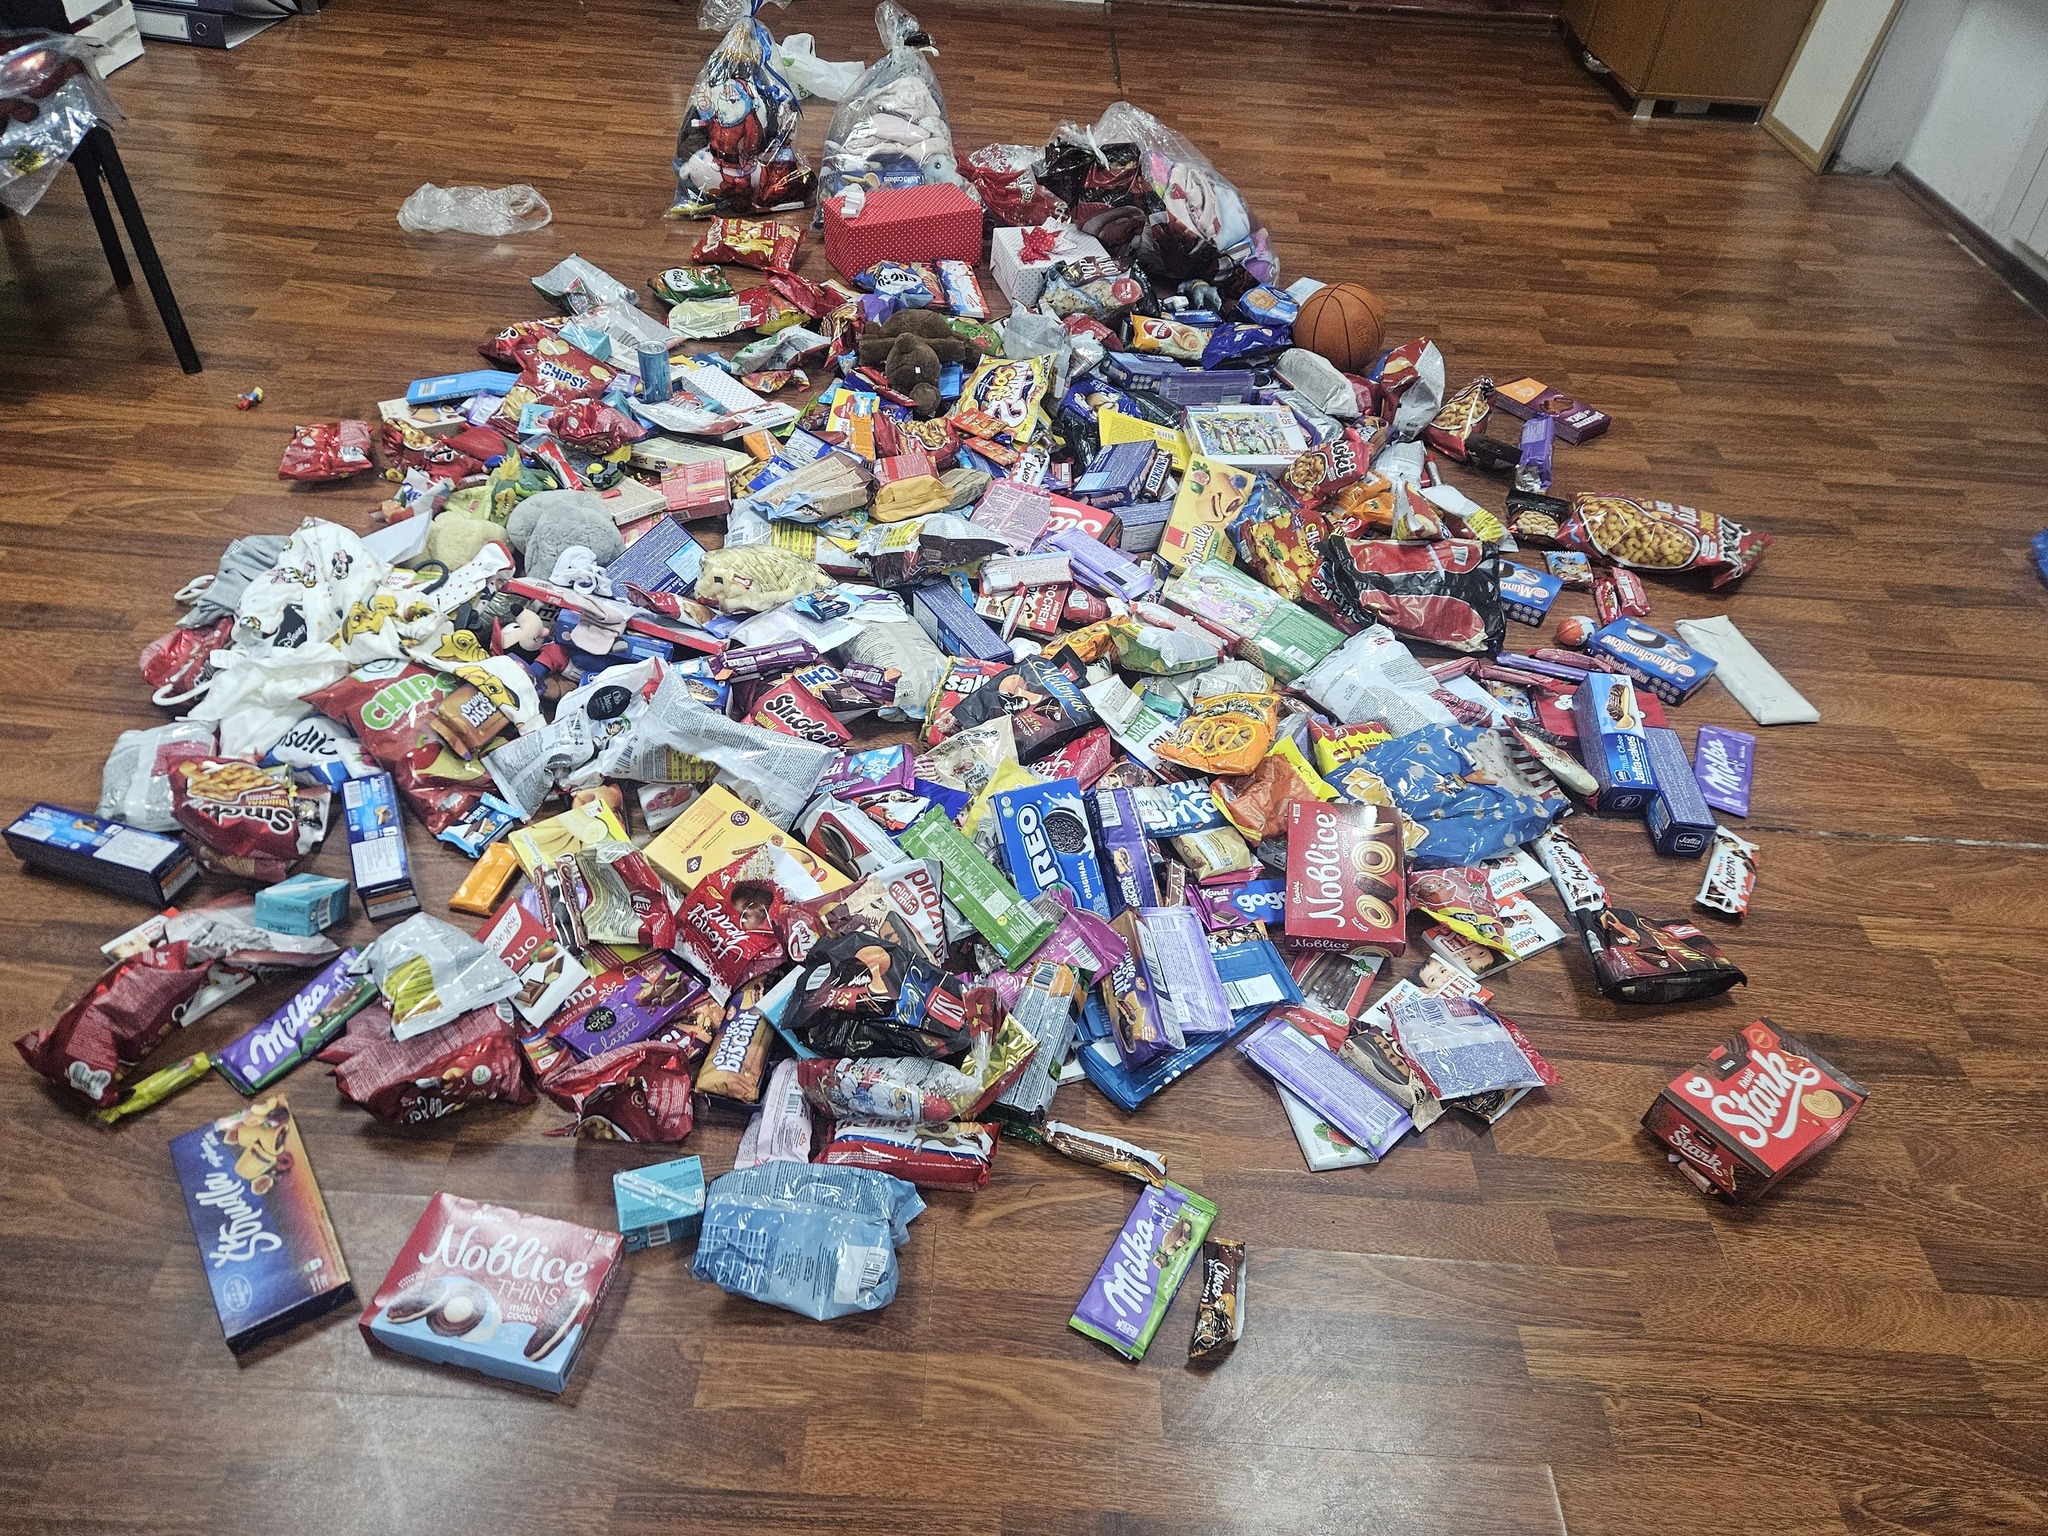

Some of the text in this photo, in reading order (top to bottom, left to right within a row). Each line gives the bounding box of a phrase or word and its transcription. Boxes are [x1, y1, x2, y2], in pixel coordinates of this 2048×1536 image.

[1147, 456, 1169, 492] SNICKERS
[1600, 635, 1680, 676] Munchmallow
[1630, 734, 1643, 760] cakes
[1704, 738, 1742, 794] Milka
[1339, 830, 1349, 859] original
[1077, 859, 1093, 899] ORIGINAL
[1305, 812, 1345, 928] Noblice
[1491, 868, 1523, 886] CHOCOLAT
[1553, 845, 1589, 881] bueno
[1719, 856, 1736, 890] bueno
[891, 882, 913, 900] mini
[898, 895, 918, 915] mini
[1124, 874, 1141, 908] biscuit
[1199, 888, 1231, 902] Kandi
[1290, 937, 1350, 950] Noblice
[250, 982, 330, 1067] Milka
[588, 1019, 640, 1058] Classic
[716, 1011, 761, 1073] biscuit
[713, 1020, 740, 1066] orange
[419, 1224, 594, 1289] Noblice
[1103, 1216, 1157, 1318] Milka
[1211, 1258, 1231, 1299] Choco
[507, 1311, 538, 1323] cocoa
